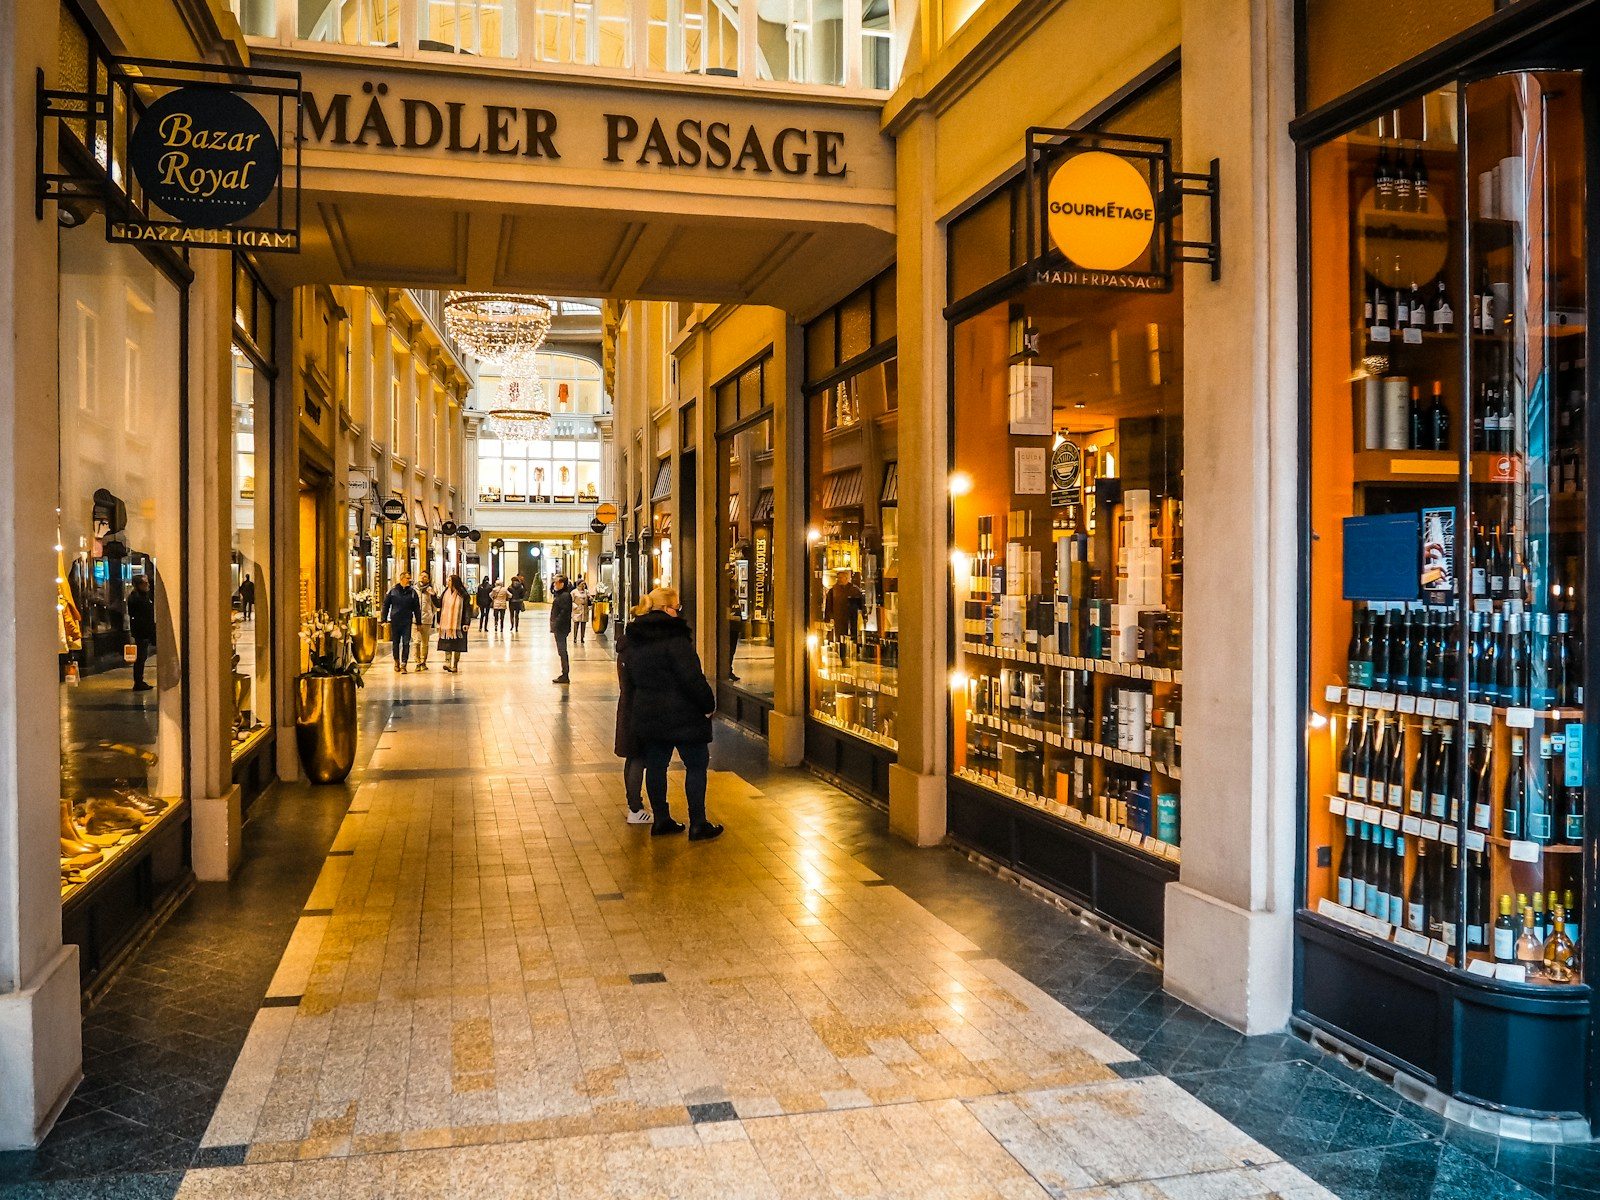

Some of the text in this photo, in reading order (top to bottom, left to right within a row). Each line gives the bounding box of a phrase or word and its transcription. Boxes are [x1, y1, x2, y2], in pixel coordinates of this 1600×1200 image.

[158, 112, 260, 152] Bazar
[295, 81, 847, 179] MÄDLER PASSAGE
[157, 151, 257, 197] Royal
[1050, 201, 1153, 221] GOURMÉTAGE
